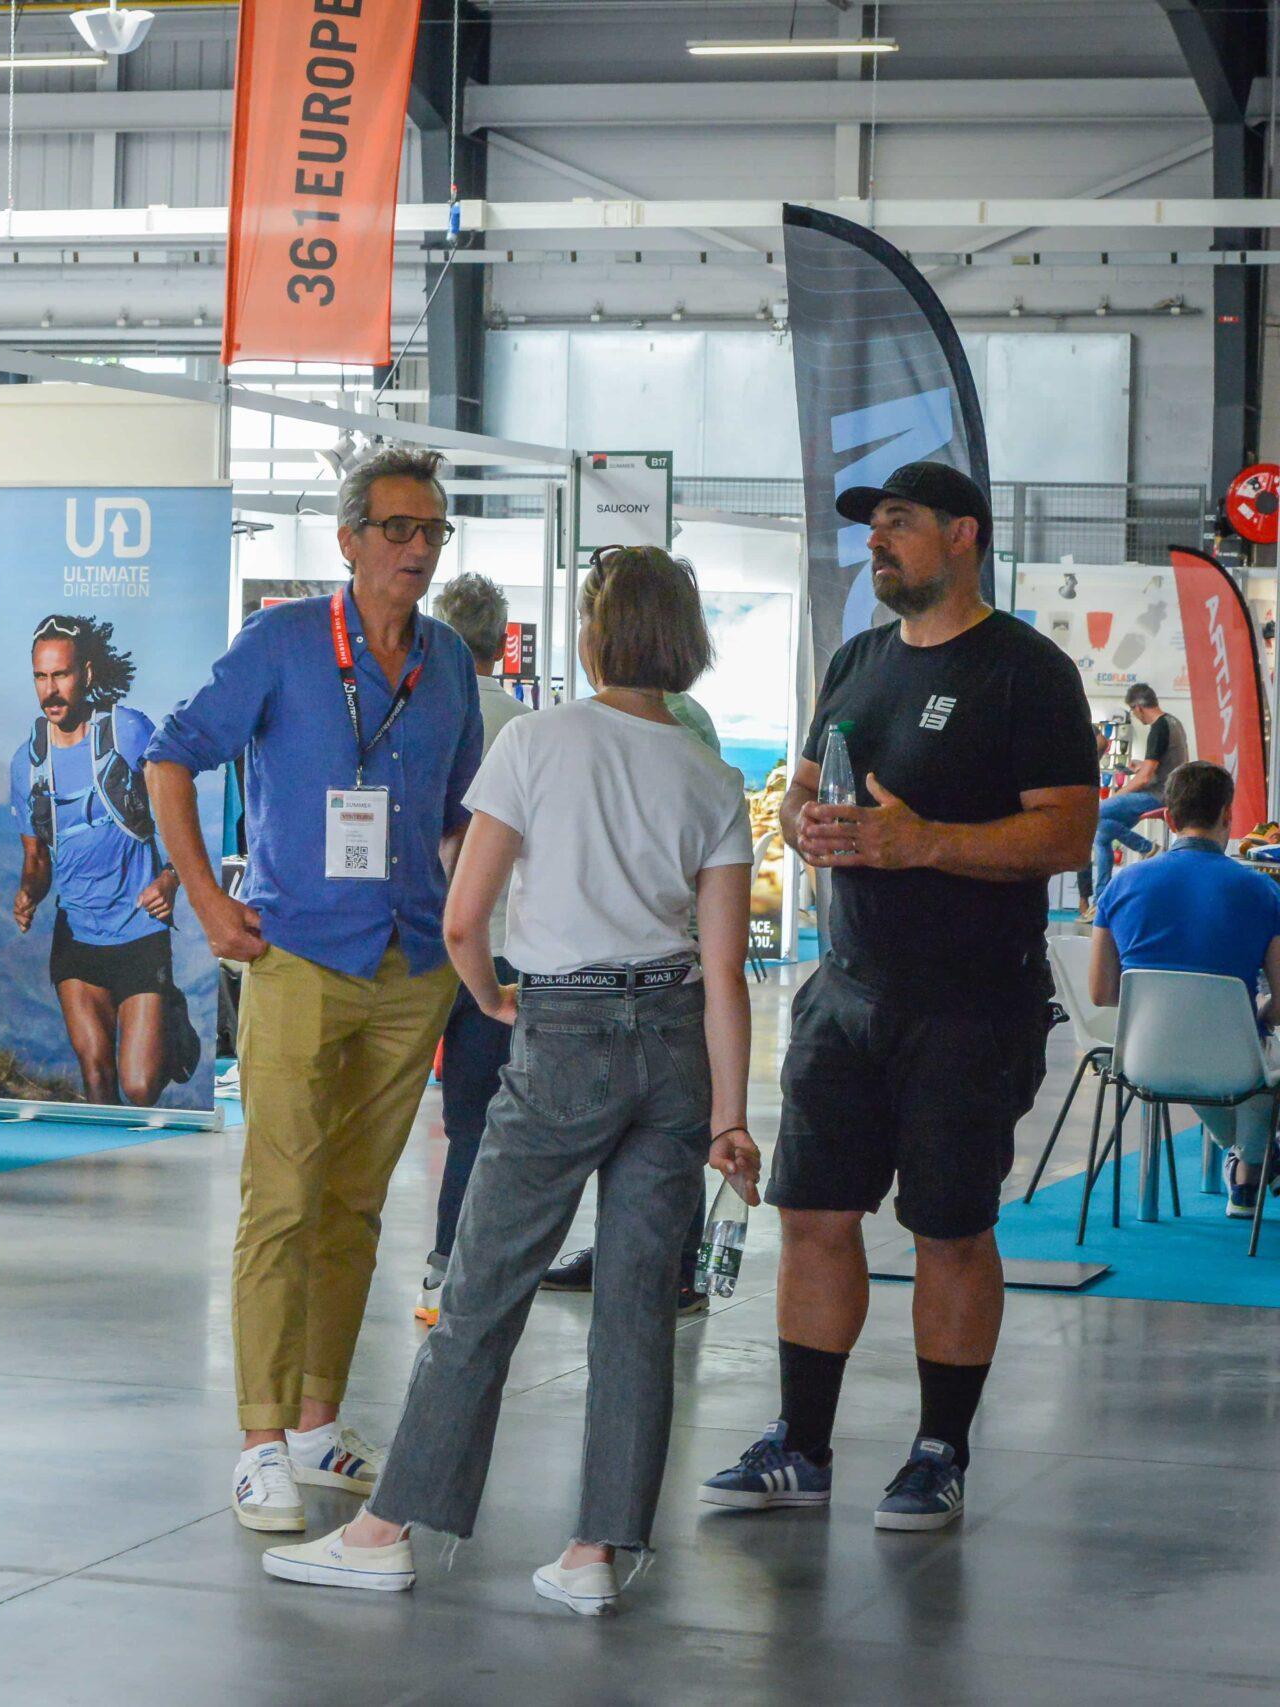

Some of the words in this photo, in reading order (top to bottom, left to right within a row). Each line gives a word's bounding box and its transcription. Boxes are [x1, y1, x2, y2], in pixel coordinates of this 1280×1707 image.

[651, 457, 667, 467] B17
[596, 504, 650, 513] SAUCONY
[63, 566, 150, 583] ULTIMATE
[63, 583, 150, 598] DIRECTION
[1096, 672, 1137, 683] ECOFLASK
